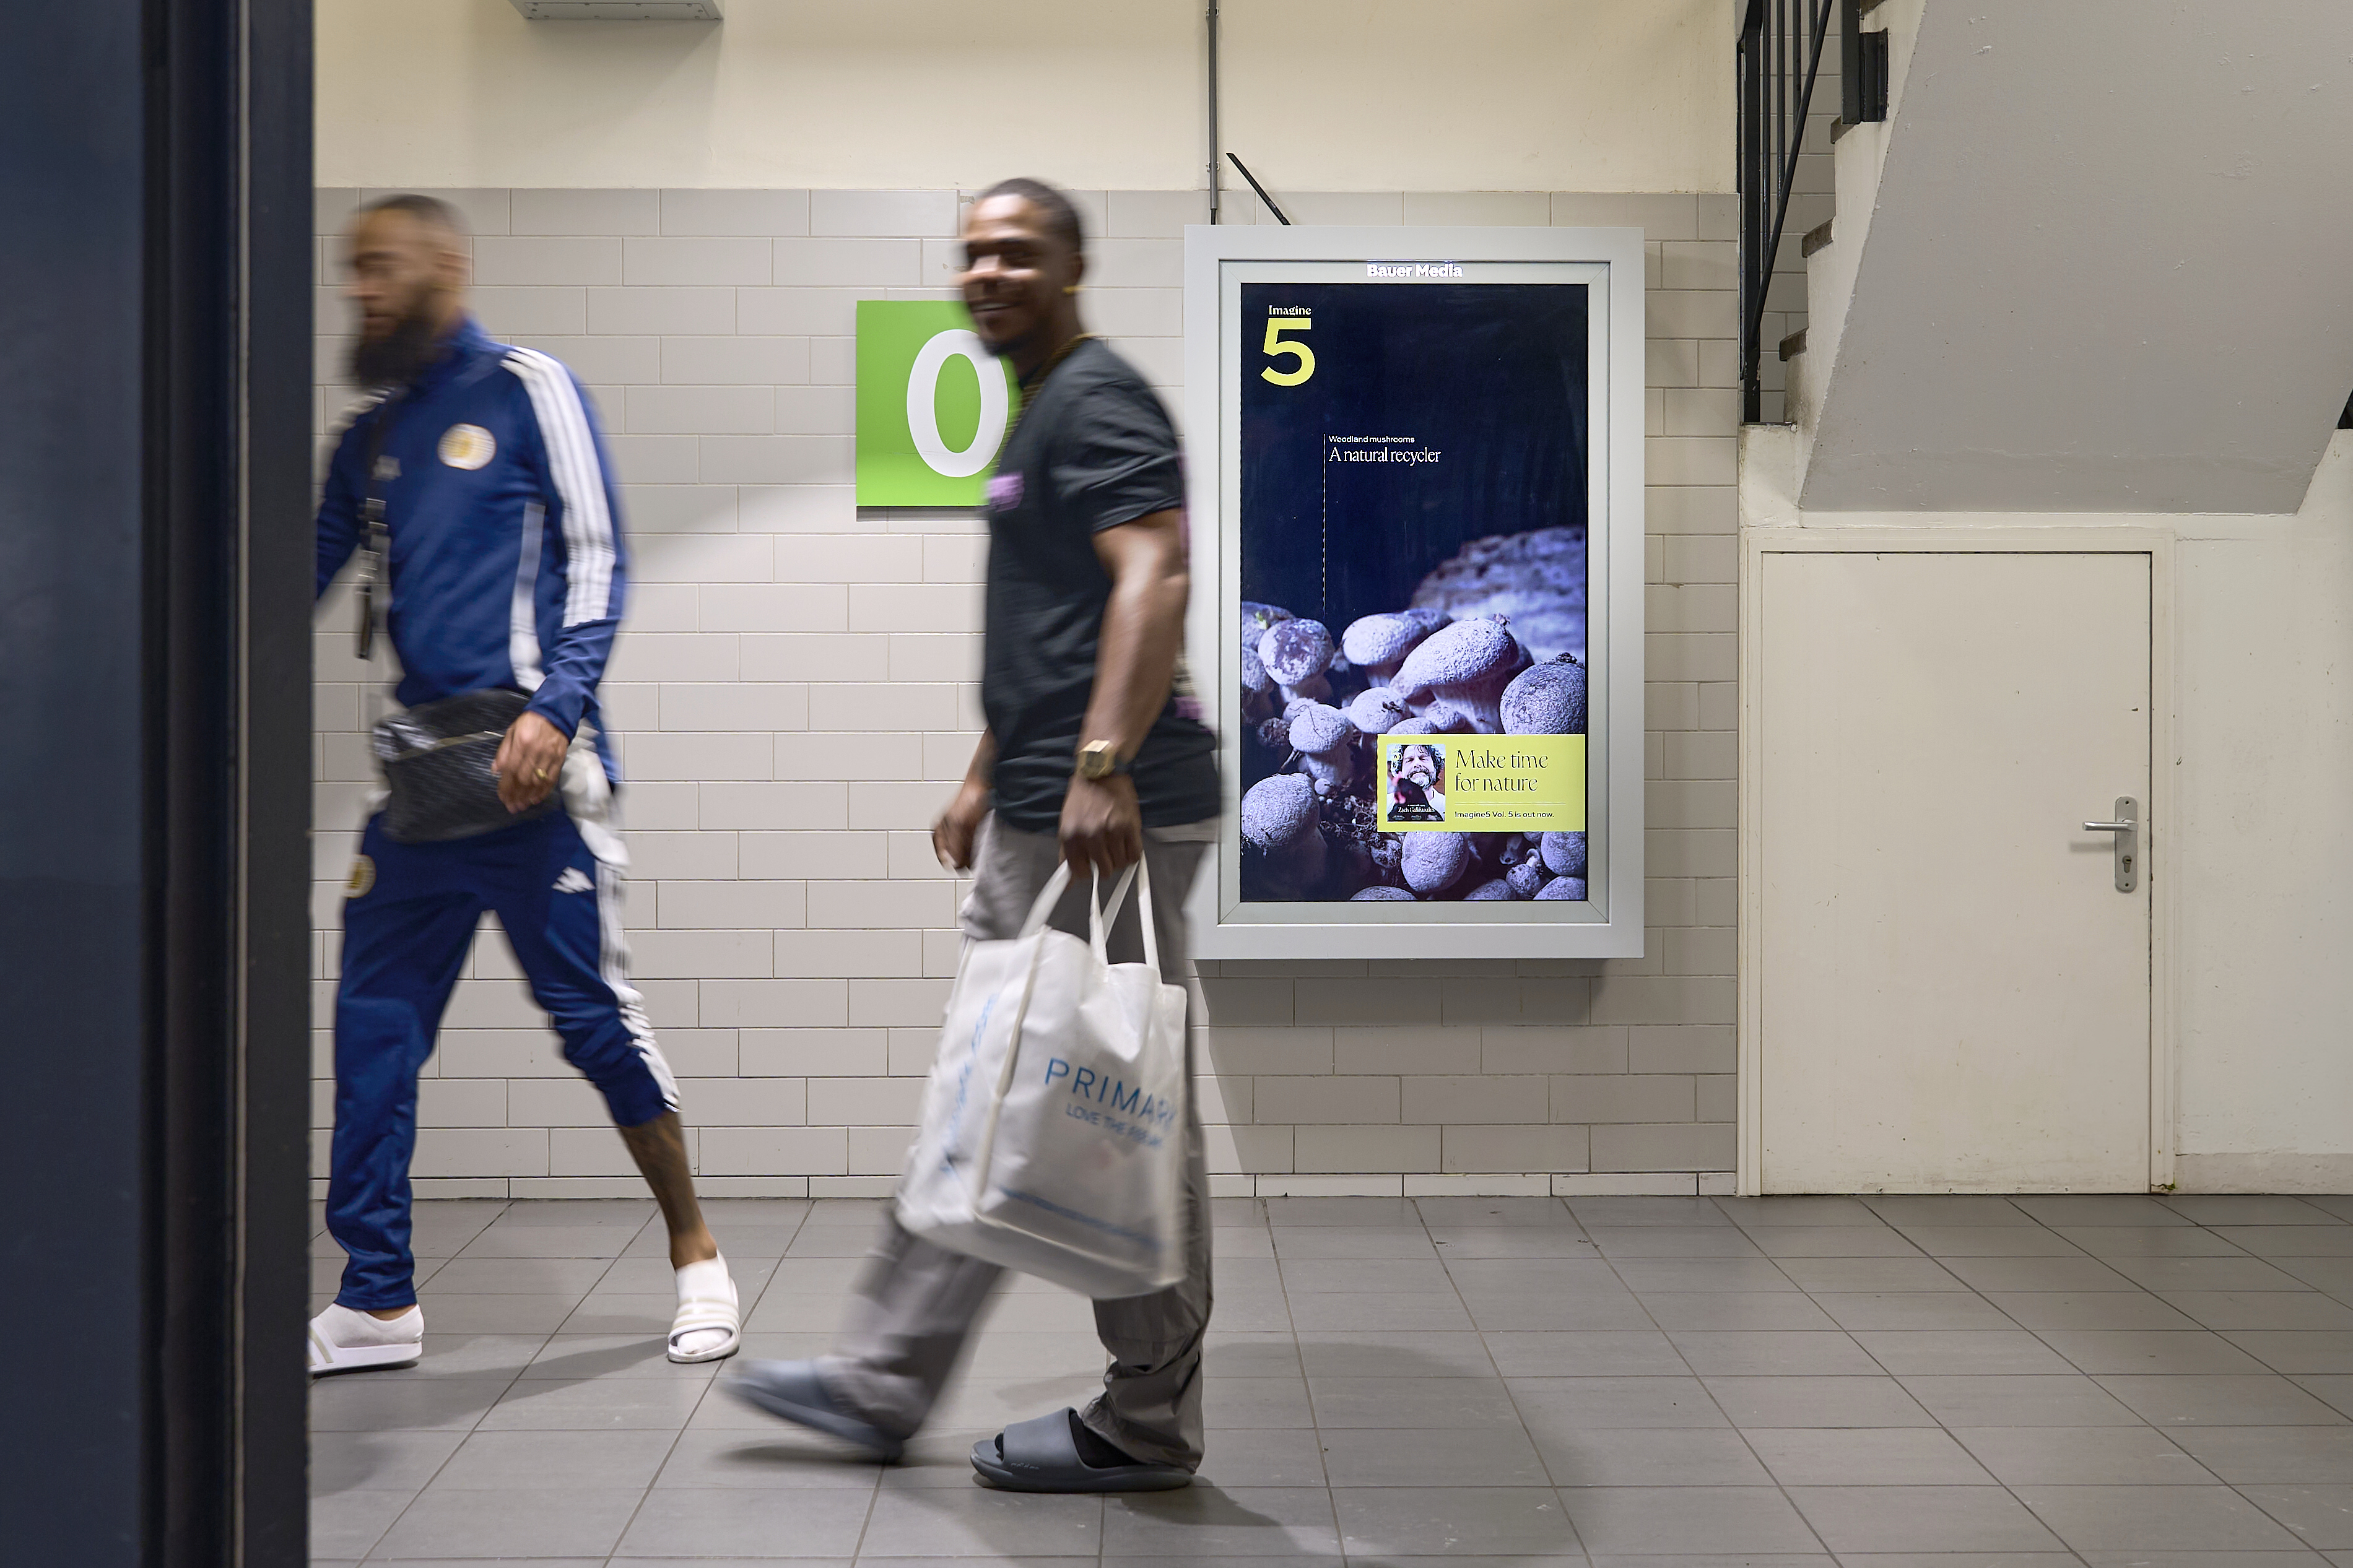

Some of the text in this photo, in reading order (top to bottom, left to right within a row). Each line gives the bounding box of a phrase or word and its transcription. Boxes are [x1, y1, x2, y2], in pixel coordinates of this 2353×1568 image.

[1367, 263, 1463, 277] Bauer Media
[1268, 305, 1311, 316] Imagine
[1261, 318, 1316, 386] 5
[907, 329, 1009, 477] 0
[1328, 435, 1415, 443] Woodland mushrooms
[1328, 446, 1442, 467] A natural recycler
[1455, 750, 1549, 768] Make time
[1455, 772, 1538, 791] for nature
[1455, 811, 1490, 819] Imagine5
